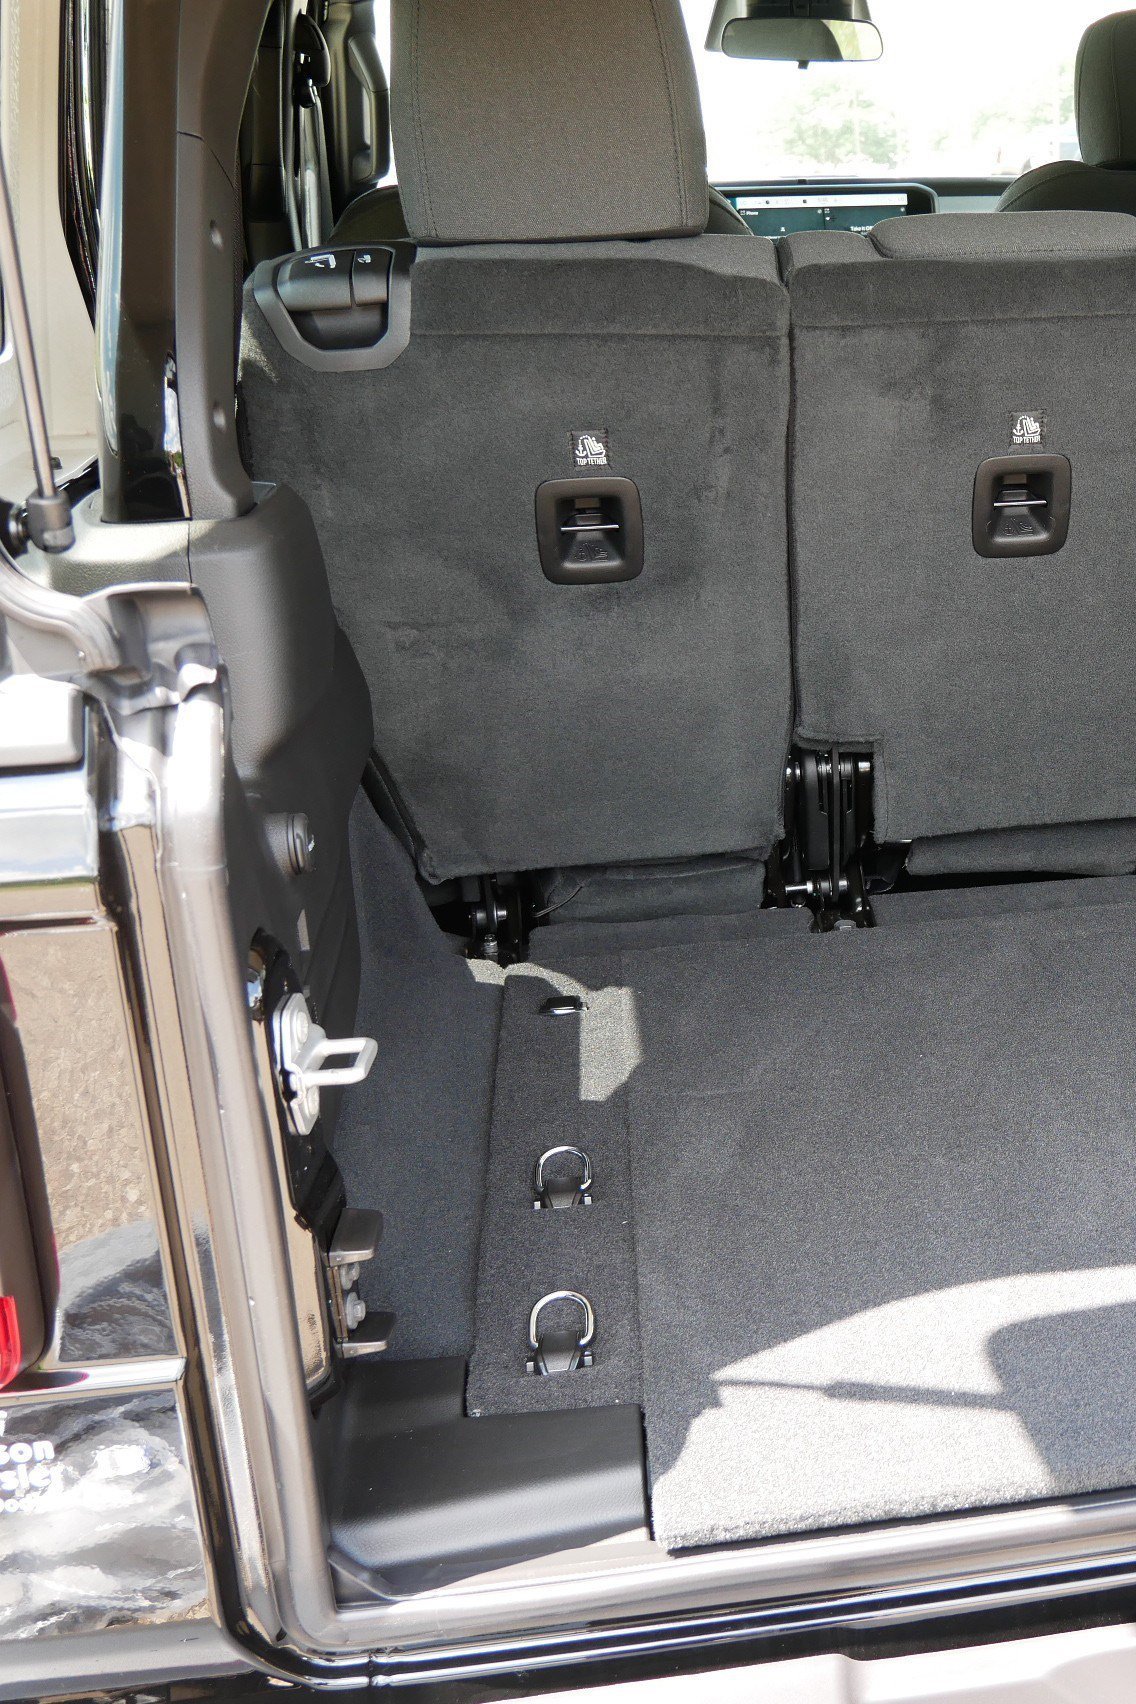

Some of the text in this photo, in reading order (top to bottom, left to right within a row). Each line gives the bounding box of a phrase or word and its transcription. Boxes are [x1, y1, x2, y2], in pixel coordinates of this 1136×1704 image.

[1012, 435, 1041, 444] TOP TETHER
[576, 457, 607, 466] TOP TETHER
